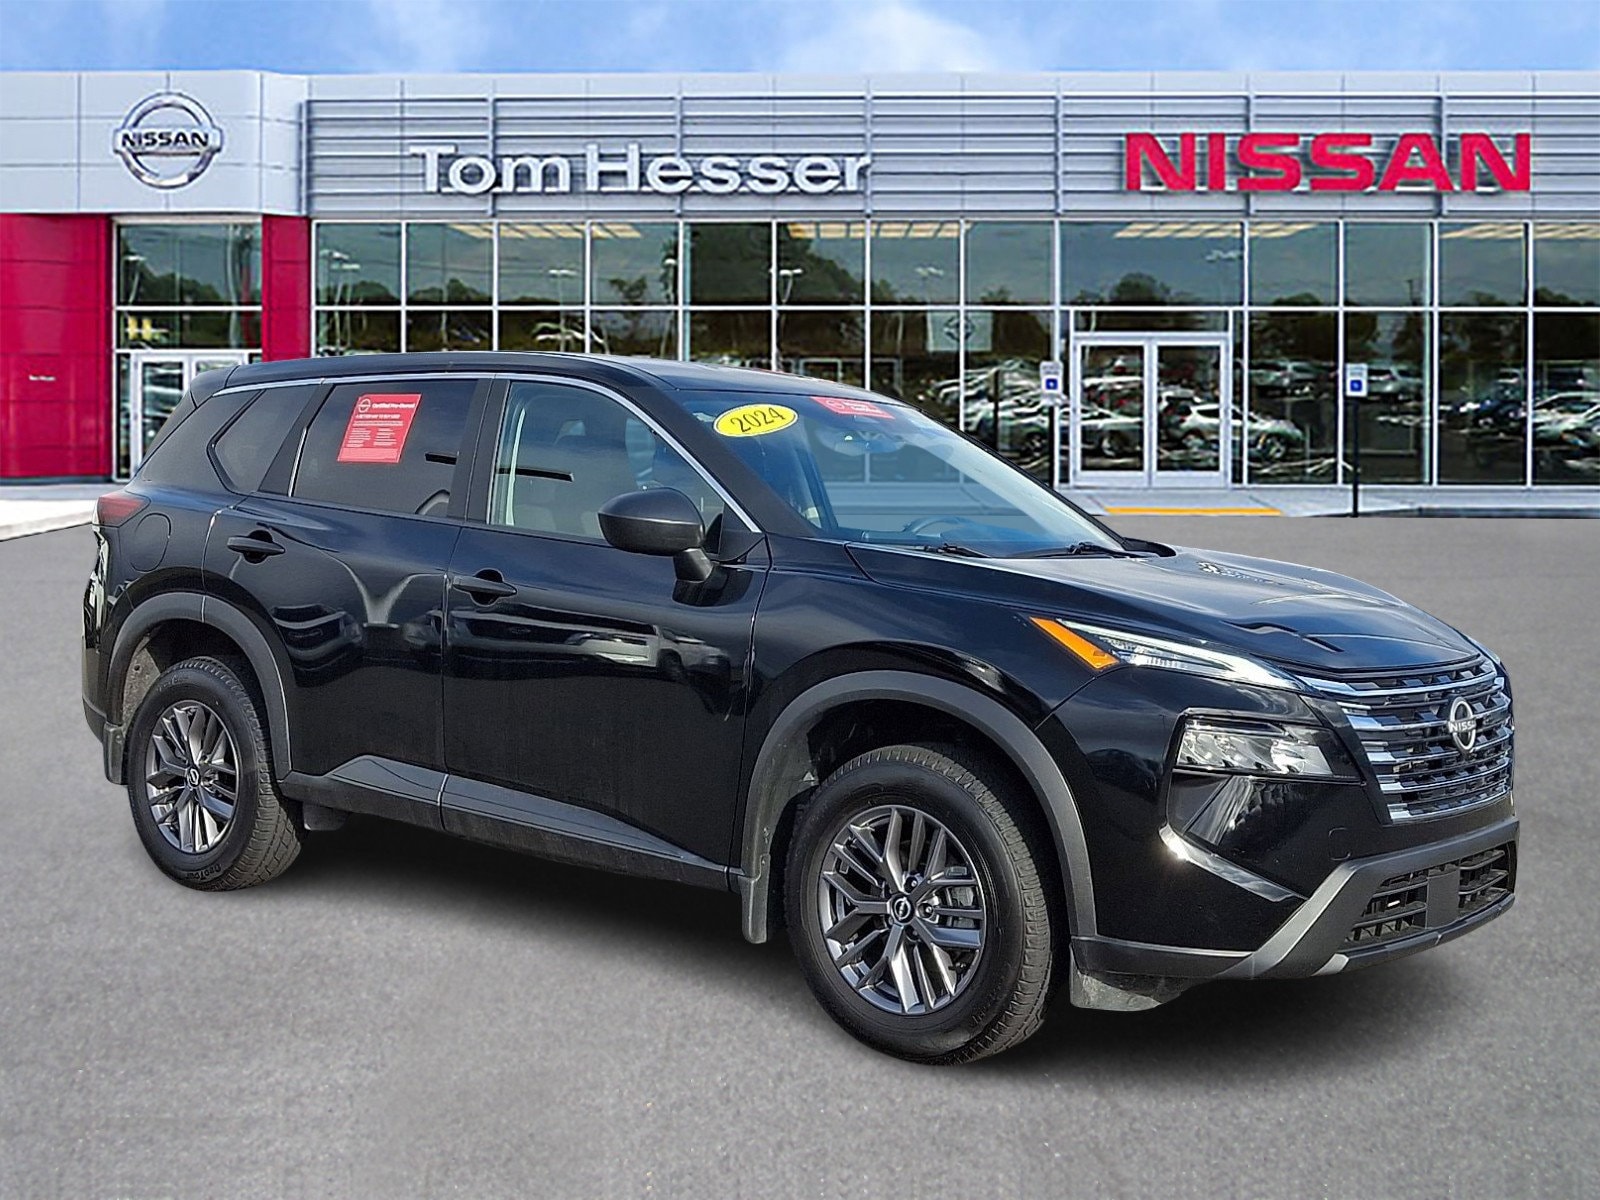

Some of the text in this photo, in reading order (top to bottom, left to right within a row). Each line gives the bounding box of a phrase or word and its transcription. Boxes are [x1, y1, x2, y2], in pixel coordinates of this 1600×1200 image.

[121, 132, 209, 147] NISSAN
[409, 143, 871, 194] Tom Hesser
[1125, 132, 1531, 191] NISSAN
[730, 407, 785, 433] 2024
